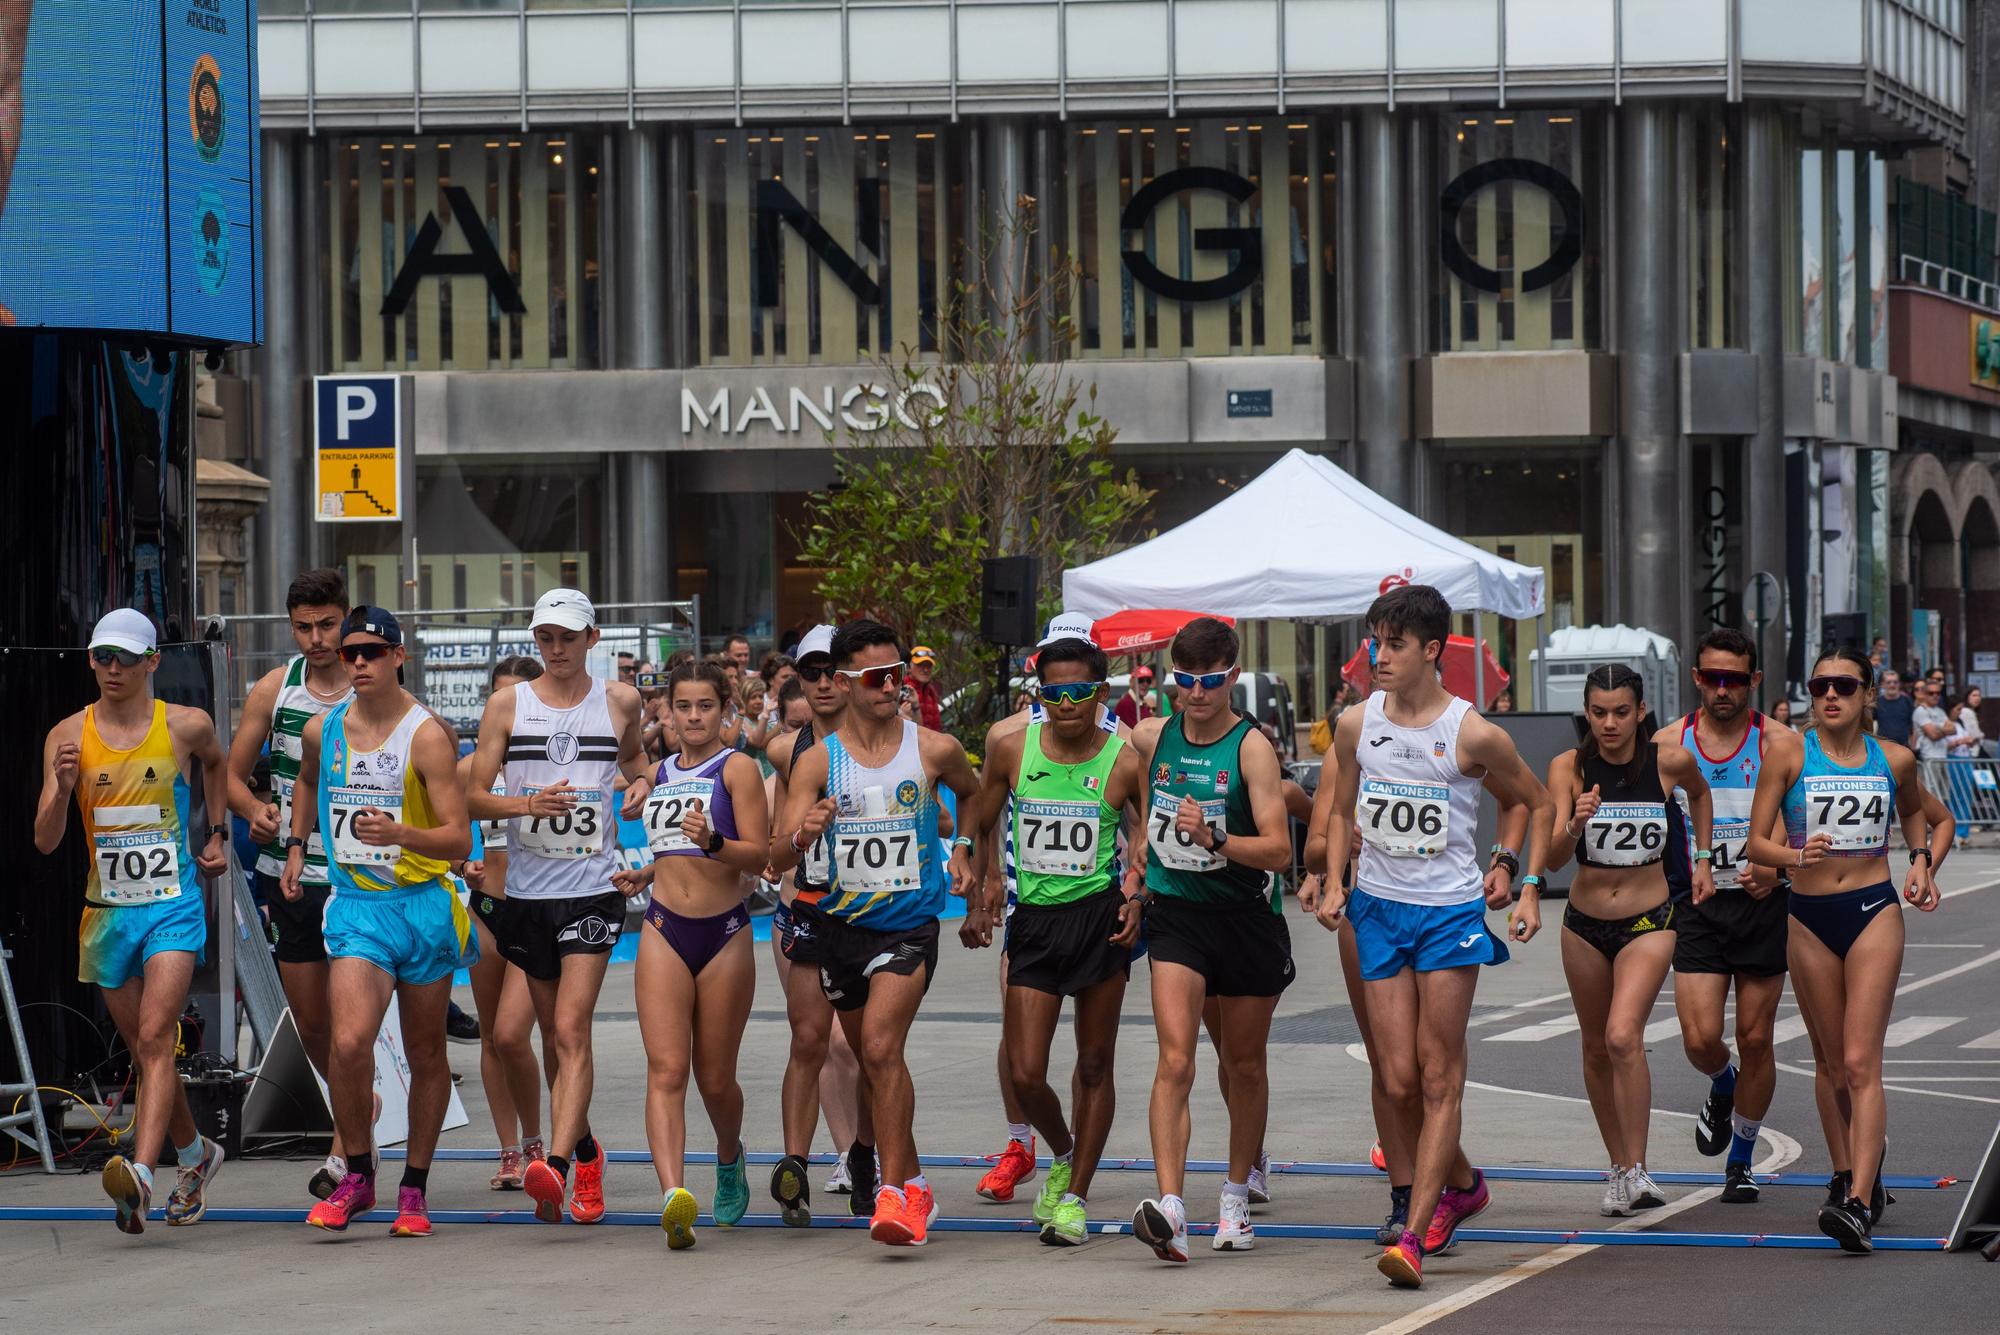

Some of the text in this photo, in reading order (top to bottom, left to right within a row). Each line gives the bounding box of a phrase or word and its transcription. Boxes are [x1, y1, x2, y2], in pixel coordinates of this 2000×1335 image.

[186, 10, 228, 35] ATHLETICS
[336, 385, 377, 441] P
[681, 383, 949, 434] MANGO
[321, 452, 394, 461] ENTRADA PARKING
[1053, 626, 1087, 635] FRANCE
[653, 783, 711, 797] CANTONES23
[1369, 782, 1448, 800] CANTONES23
[1811, 781, 1887, 792] CANTONES23
[332, 794, 400, 806] CANTONES23
[1022, 803, 1097, 817] CANTONES23
[1367, 797, 1443, 836] 706
[1594, 808, 1664, 817] ANTONES23
[1813, 795, 1885, 826] 724
[839, 820, 913, 833] CANTONES23
[1023, 818, 1093, 853] 710
[1591, 822, 1662, 851] 726
[841, 835, 912, 869] 707
[101, 847, 173, 881] 702
[1631, 923, 1656, 931] adidas
